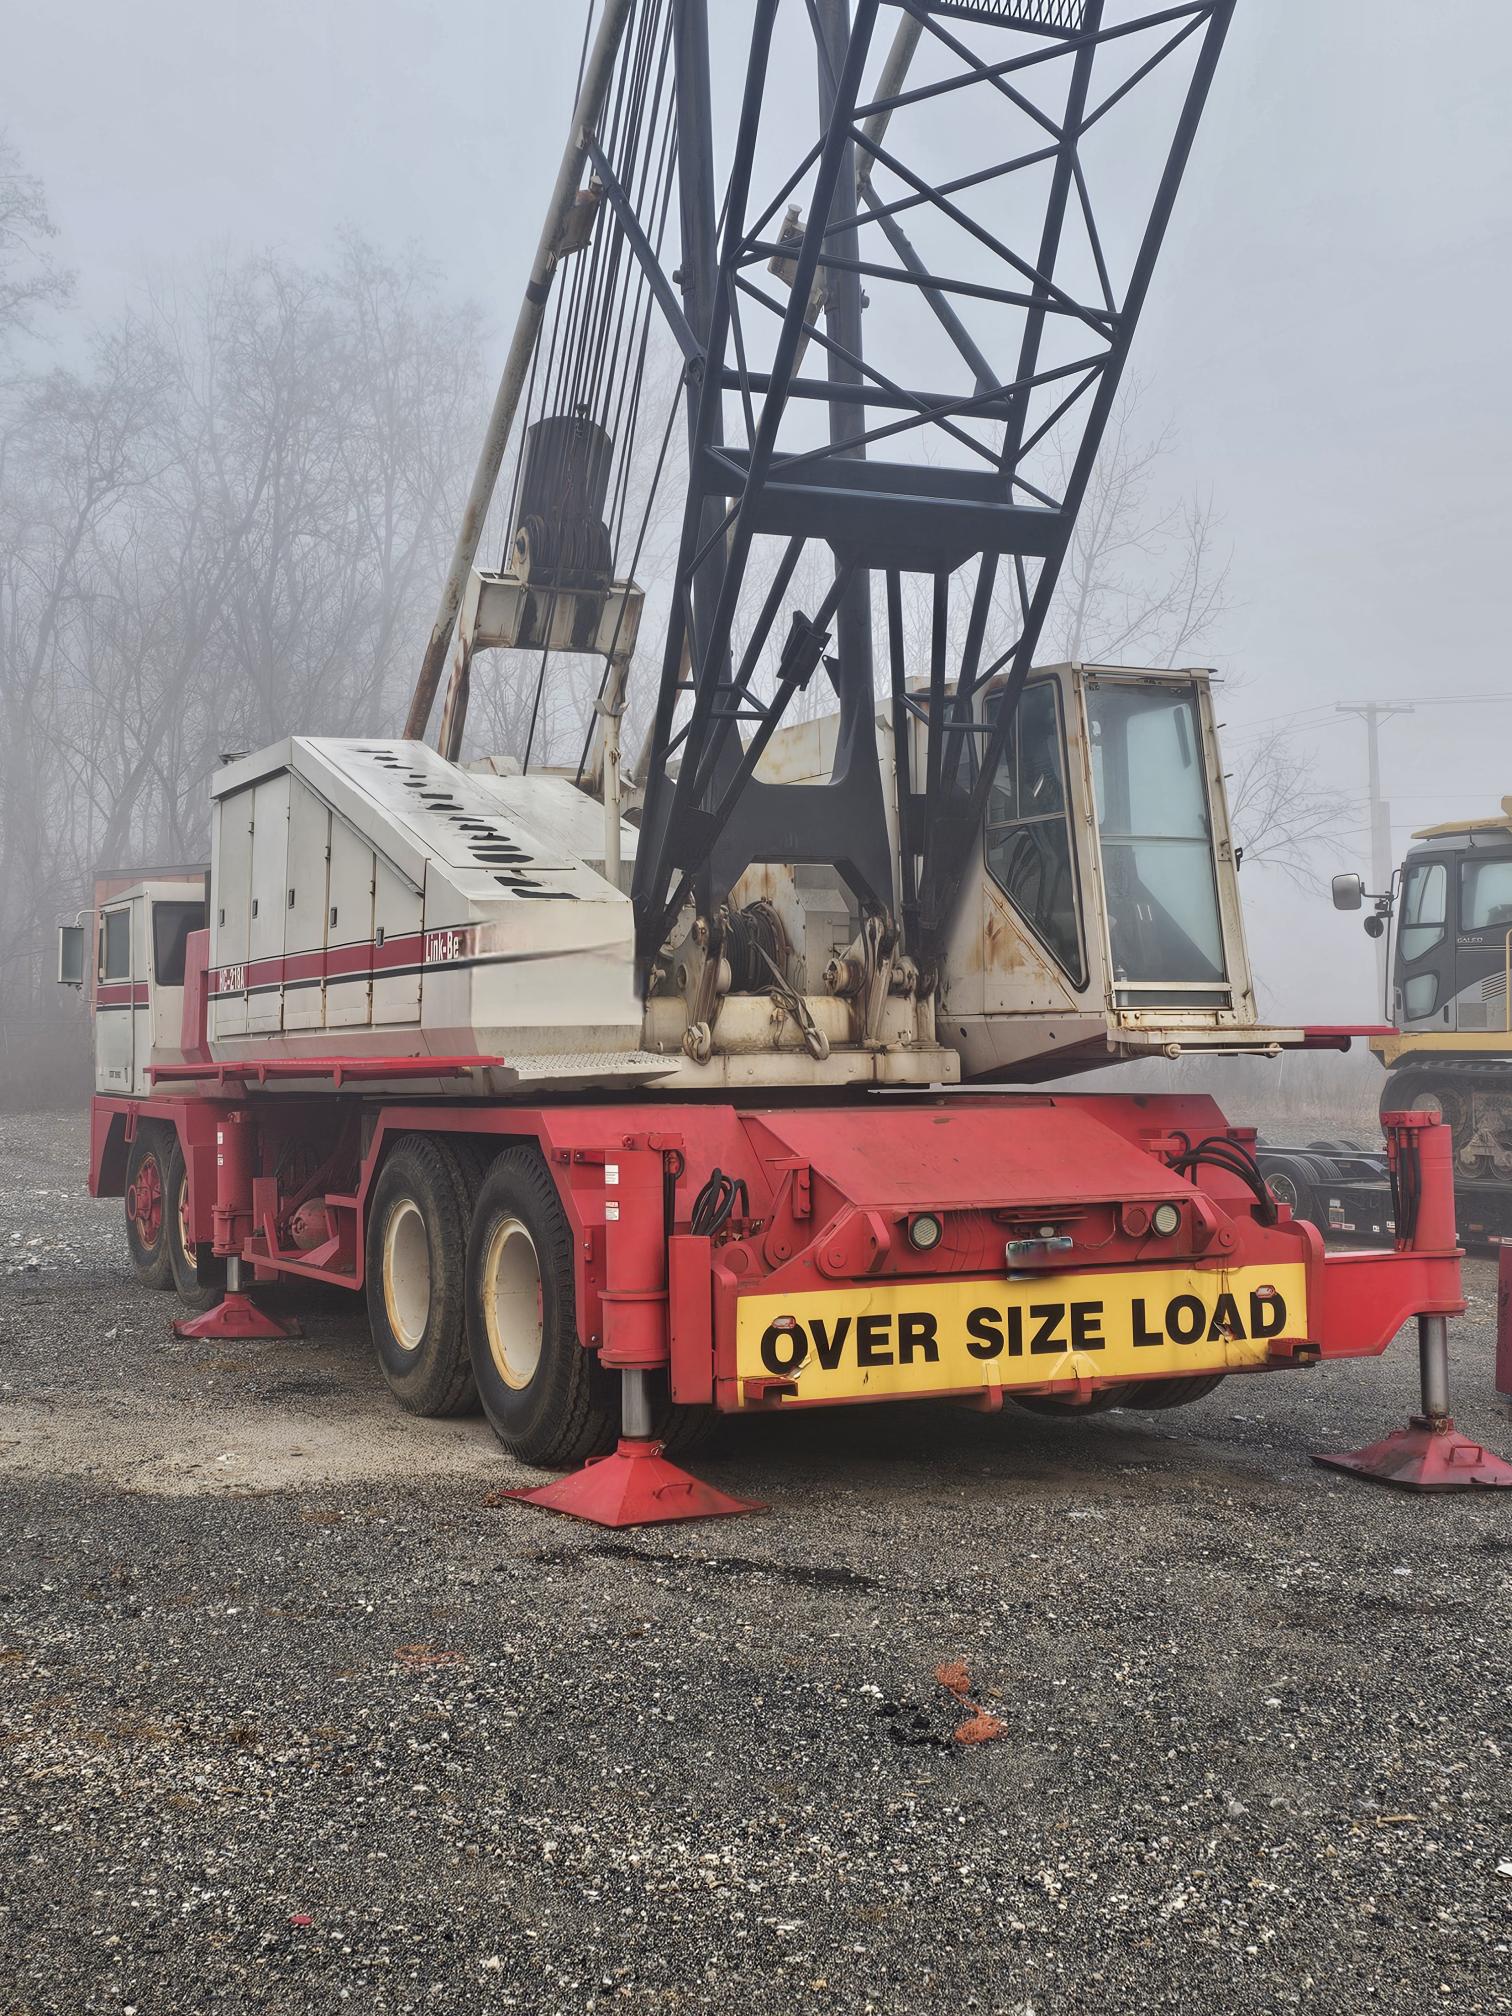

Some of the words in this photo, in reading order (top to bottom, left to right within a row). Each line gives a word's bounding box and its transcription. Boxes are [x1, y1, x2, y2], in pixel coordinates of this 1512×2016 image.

[760, 1312, 940, 1376] OVER
[966, 1301, 1106, 1360] SIZE
[1131, 1292, 1287, 1347] LOAD
